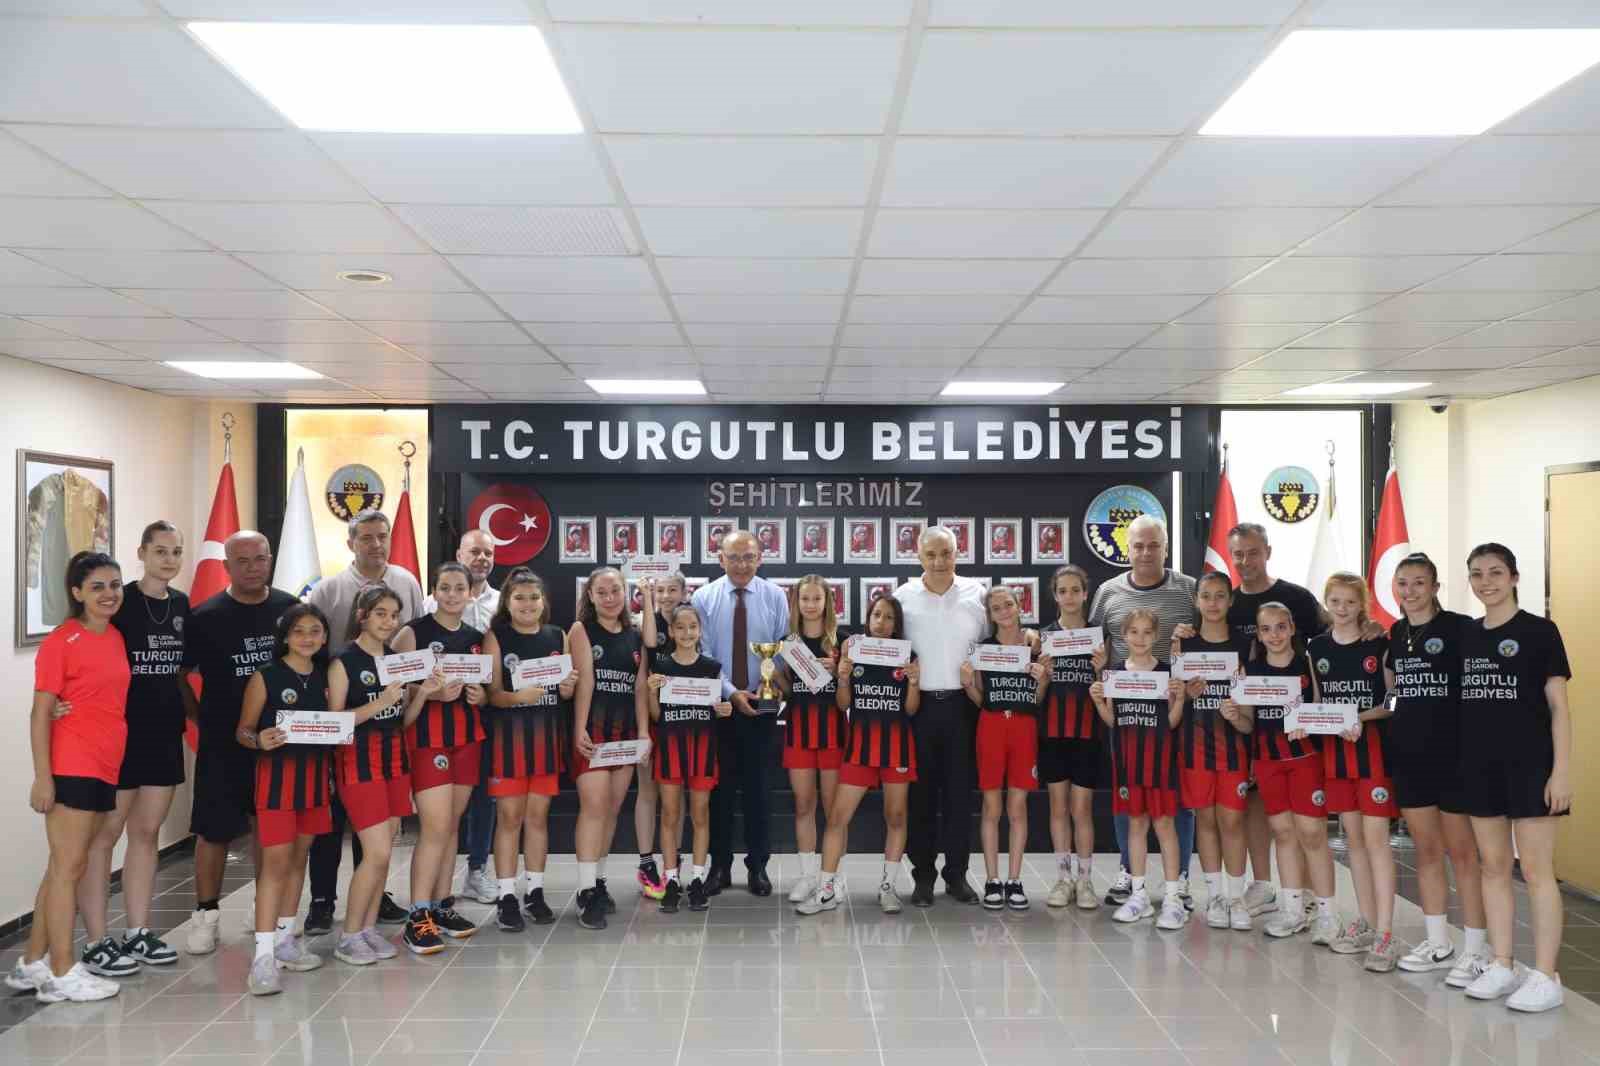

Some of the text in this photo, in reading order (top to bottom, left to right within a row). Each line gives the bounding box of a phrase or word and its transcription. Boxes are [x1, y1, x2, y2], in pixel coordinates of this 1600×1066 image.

[461, 407, 1182, 461] T.C. TURGUTLU BELEDİYESİ
[709, 477, 923, 514] ŞEHİTLERİMİZ
